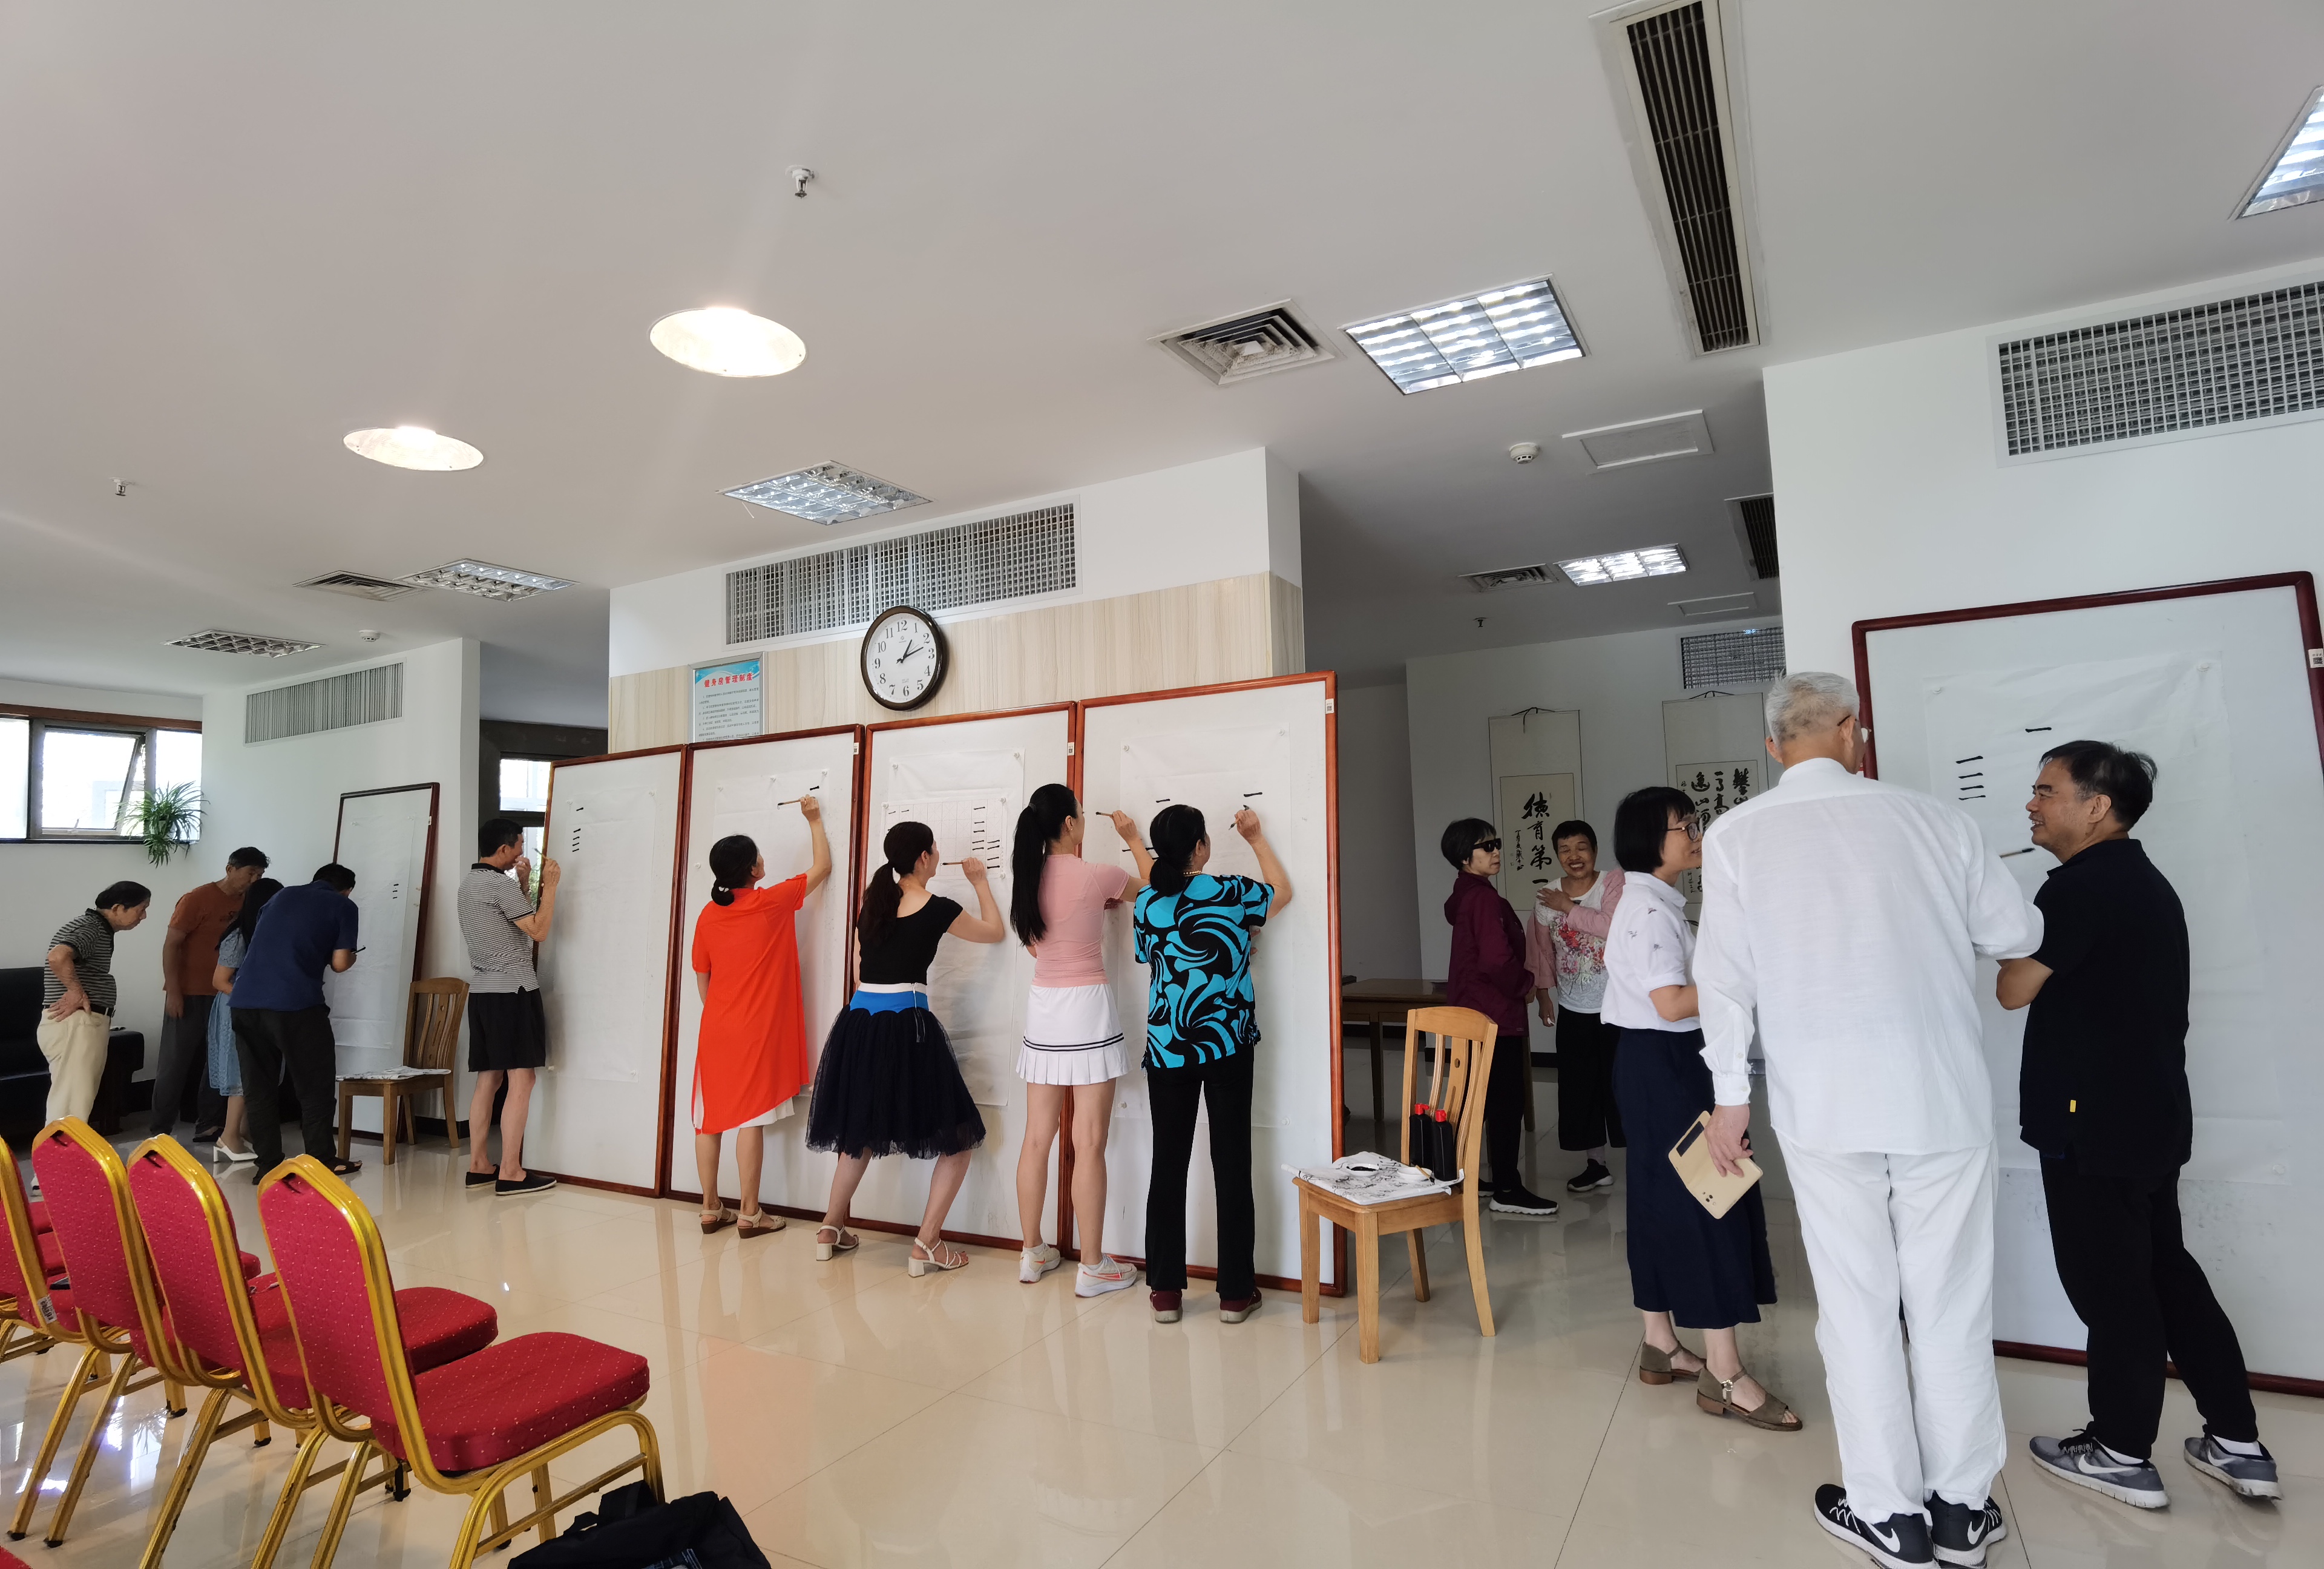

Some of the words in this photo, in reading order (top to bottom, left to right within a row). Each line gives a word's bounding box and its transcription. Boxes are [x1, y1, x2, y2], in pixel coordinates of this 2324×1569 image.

[897, 620, 908, 632] 12
[914, 622, 918, 633] 1
[886, 627, 893, 639] 11
[923, 633, 930, 643] 2
[878, 641, 886, 653] 10
[928, 648, 934, 659] 3
[875, 658, 881, 669] 9
[924, 665, 931, 676] 4
[704, 673, 753, 688] 健身房管理制度
[879, 673, 886, 684] 8
[889, 684, 895, 695] 7
[917, 679, 924, 690] 5
[902, 685, 909, 696] 6
